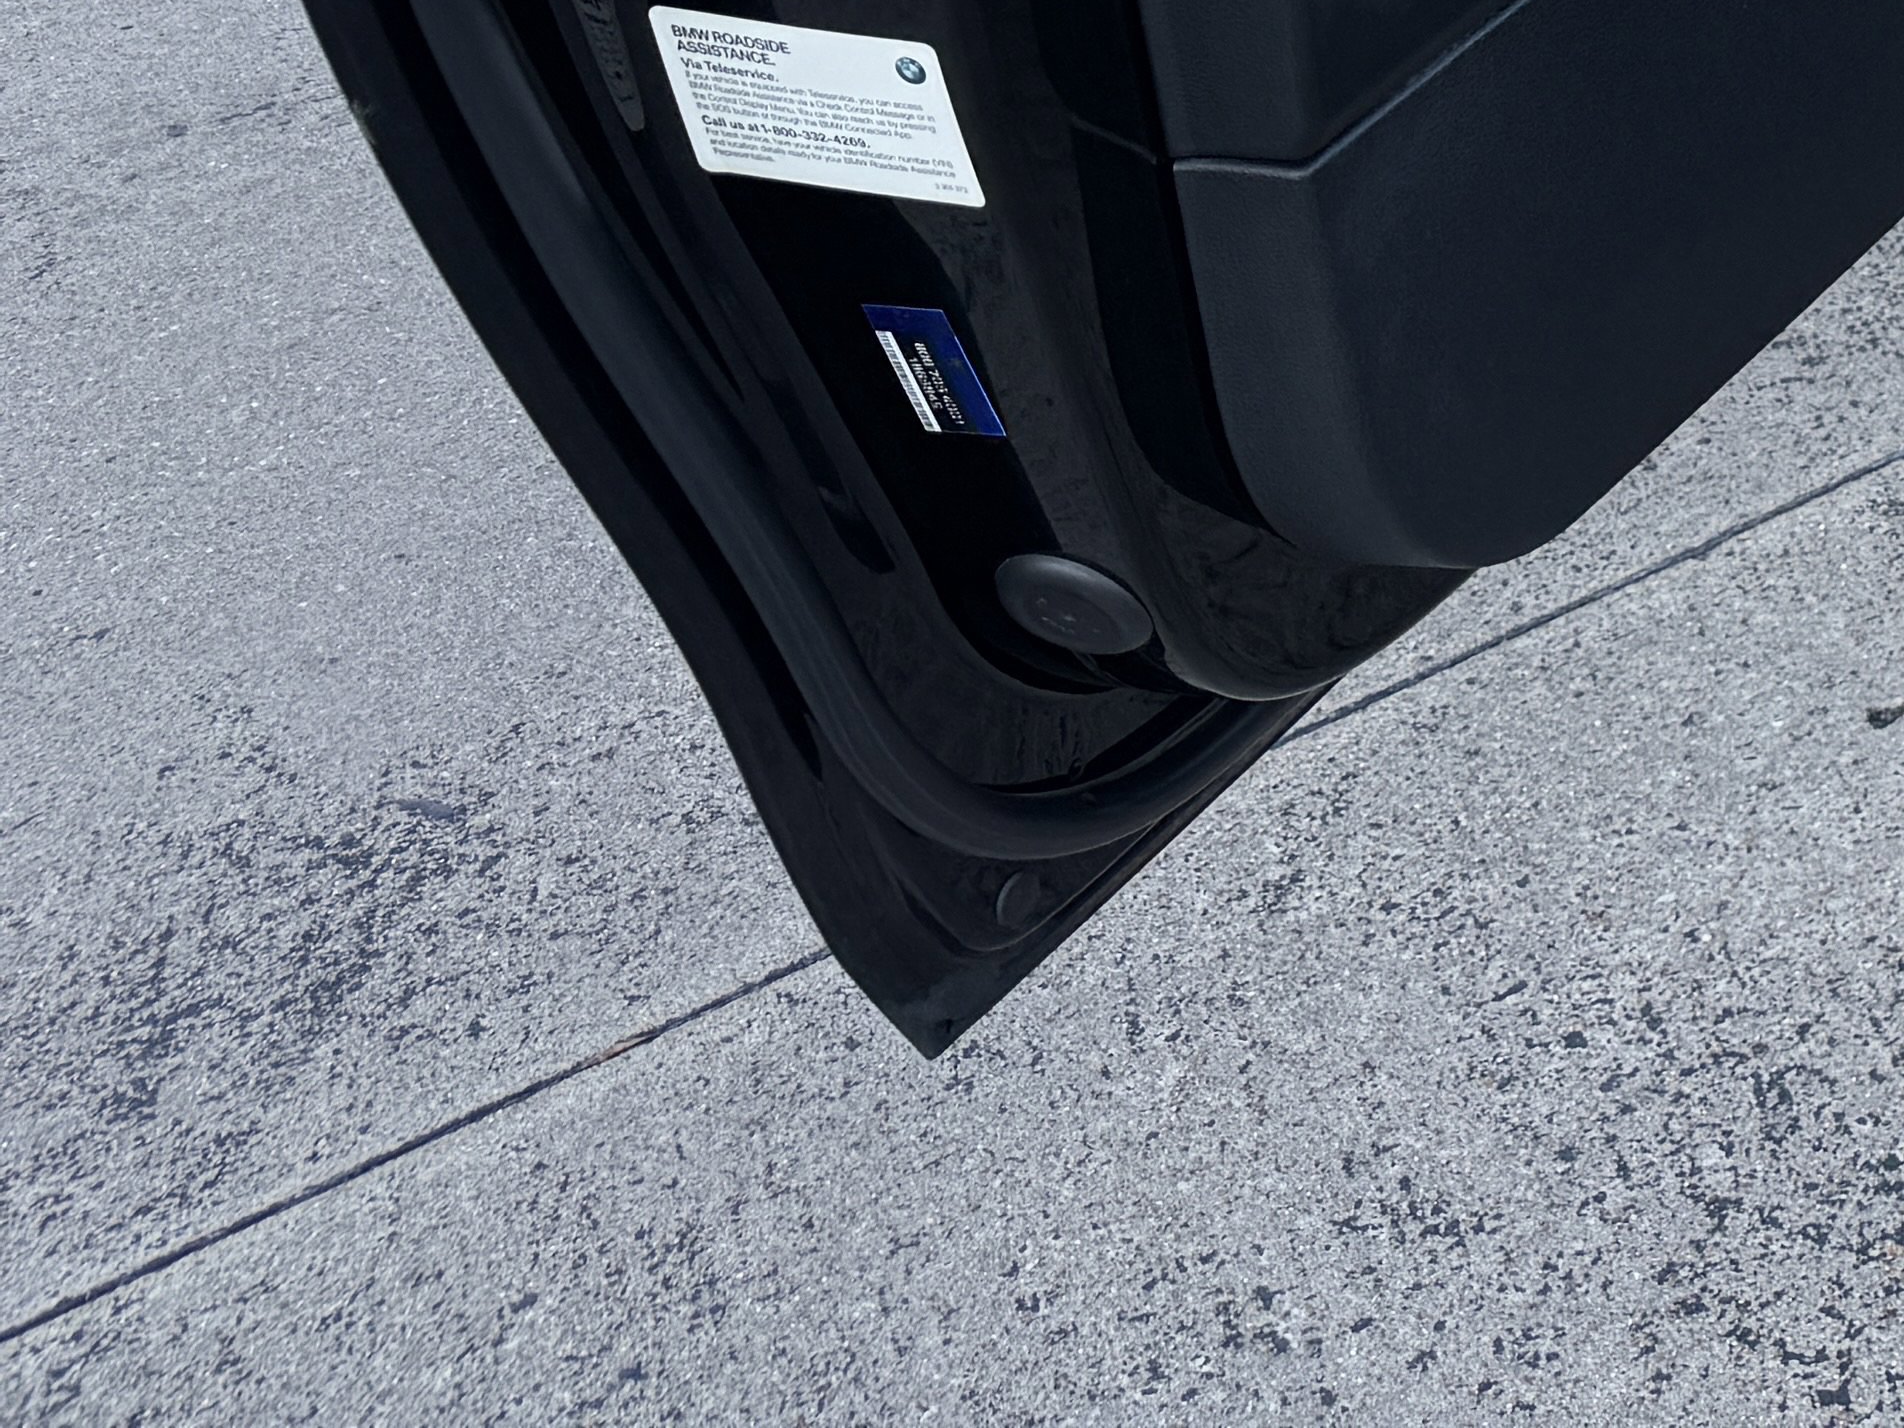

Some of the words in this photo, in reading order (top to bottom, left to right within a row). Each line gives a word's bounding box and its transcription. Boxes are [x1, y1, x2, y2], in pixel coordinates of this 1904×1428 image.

[671, 24, 711, 40] BMW
[712, 30, 791, 53] ROADSIDE
[681, 57, 702, 69] Via
[705, 61, 778, 81] Teleservice.
[701, 115, 726, 126] Call
[730, 121, 744, 129] us
[747, 123, 759, 131] at
